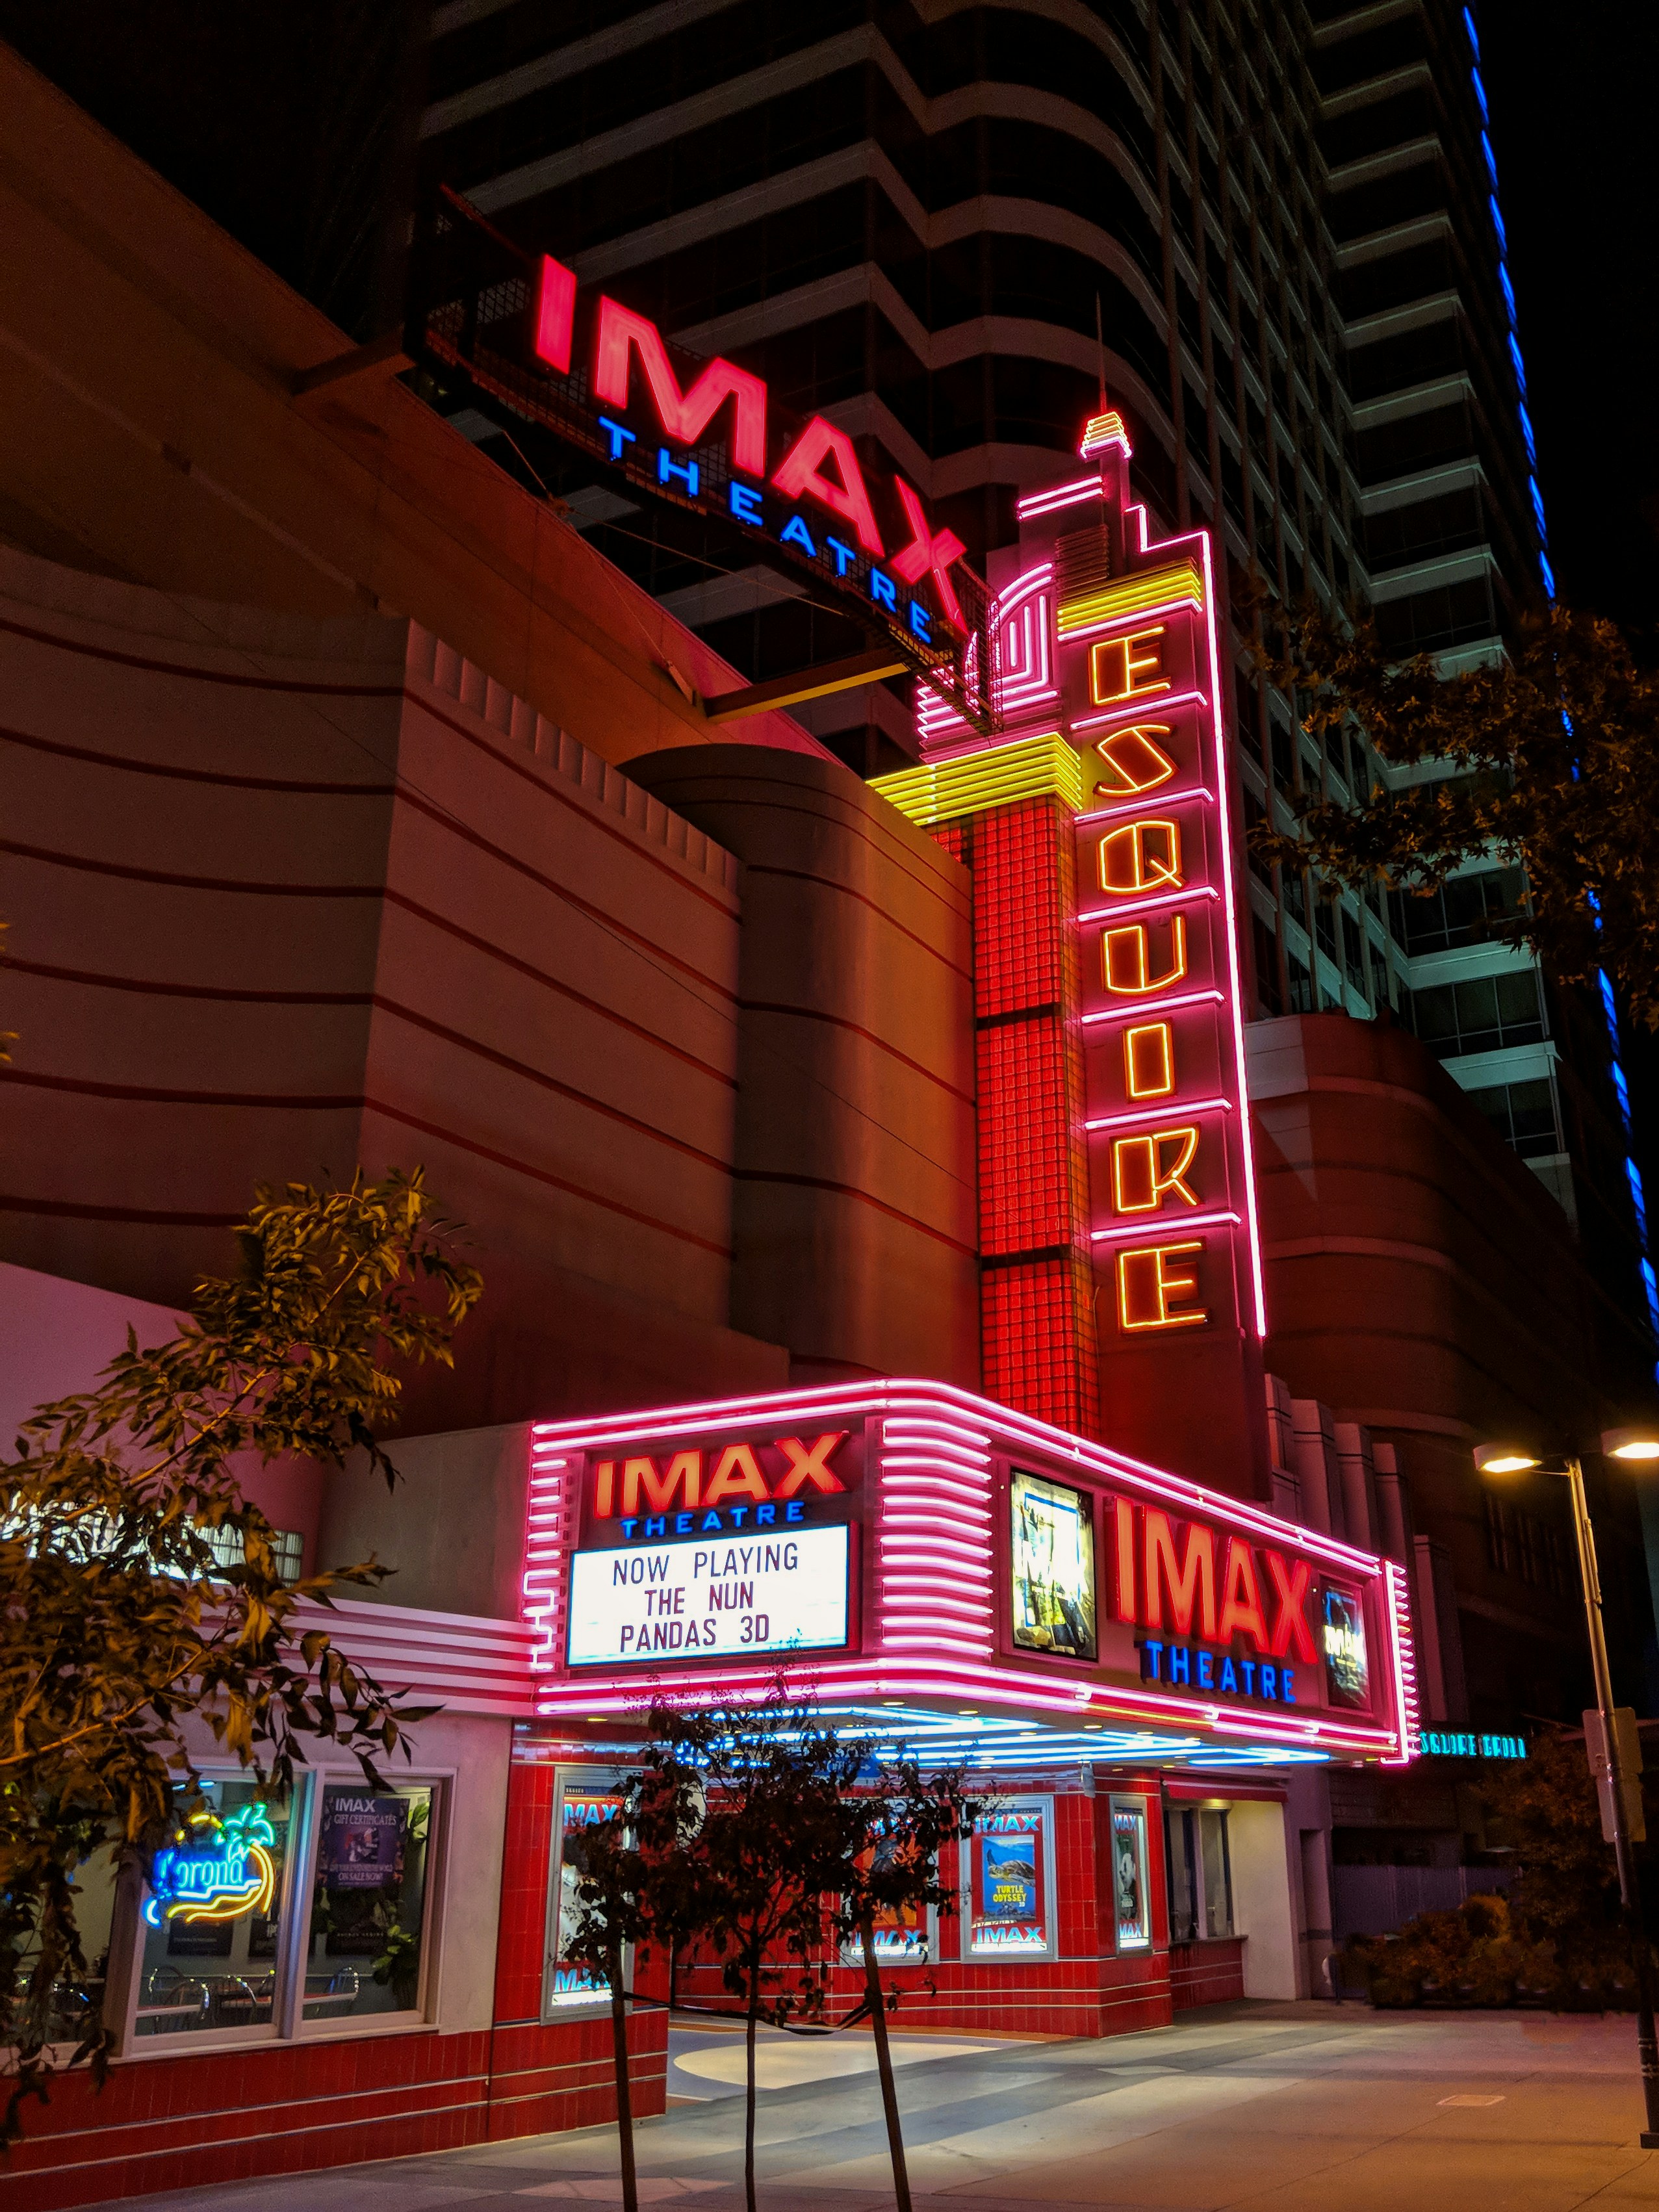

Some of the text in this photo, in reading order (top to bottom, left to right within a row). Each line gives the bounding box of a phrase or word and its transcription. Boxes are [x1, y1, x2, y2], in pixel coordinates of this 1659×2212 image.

[535, 253, 969, 641] IMAX
[598, 415, 932, 644] THEATRE
[1089, 622, 1211, 1337] ESQUIRE
[593, 1430, 849, 1519] IMAX
[621, 1500, 805, 1539] THEATRE
[613, 1542, 799, 1586] NOW PLAYING
[1111, 1495, 1319, 1665] IMAX
[644, 1580, 754, 1616] THE NUN
[620, 1614, 770, 1653] PANDAS 3D
[1144, 1640, 1296, 1704] THEATRE
[1419, 1730, 1477, 1756] SQUIRE
[333, 1814, 397, 1825] GIFT CERTIFICATES
[335, 1797, 376, 1812] IMAX
[564, 1803, 618, 1827] MAX
[975, 1815, 1040, 1833] IMAX
[1114, 1814, 1137, 1831] MAX
[992, 1893, 1027, 1903] ODYSSEY
[996, 1885, 1024, 1894] TURTLE
[977, 1927, 1043, 1944] IMAX
[1119, 1922, 1142, 1938] MAX
